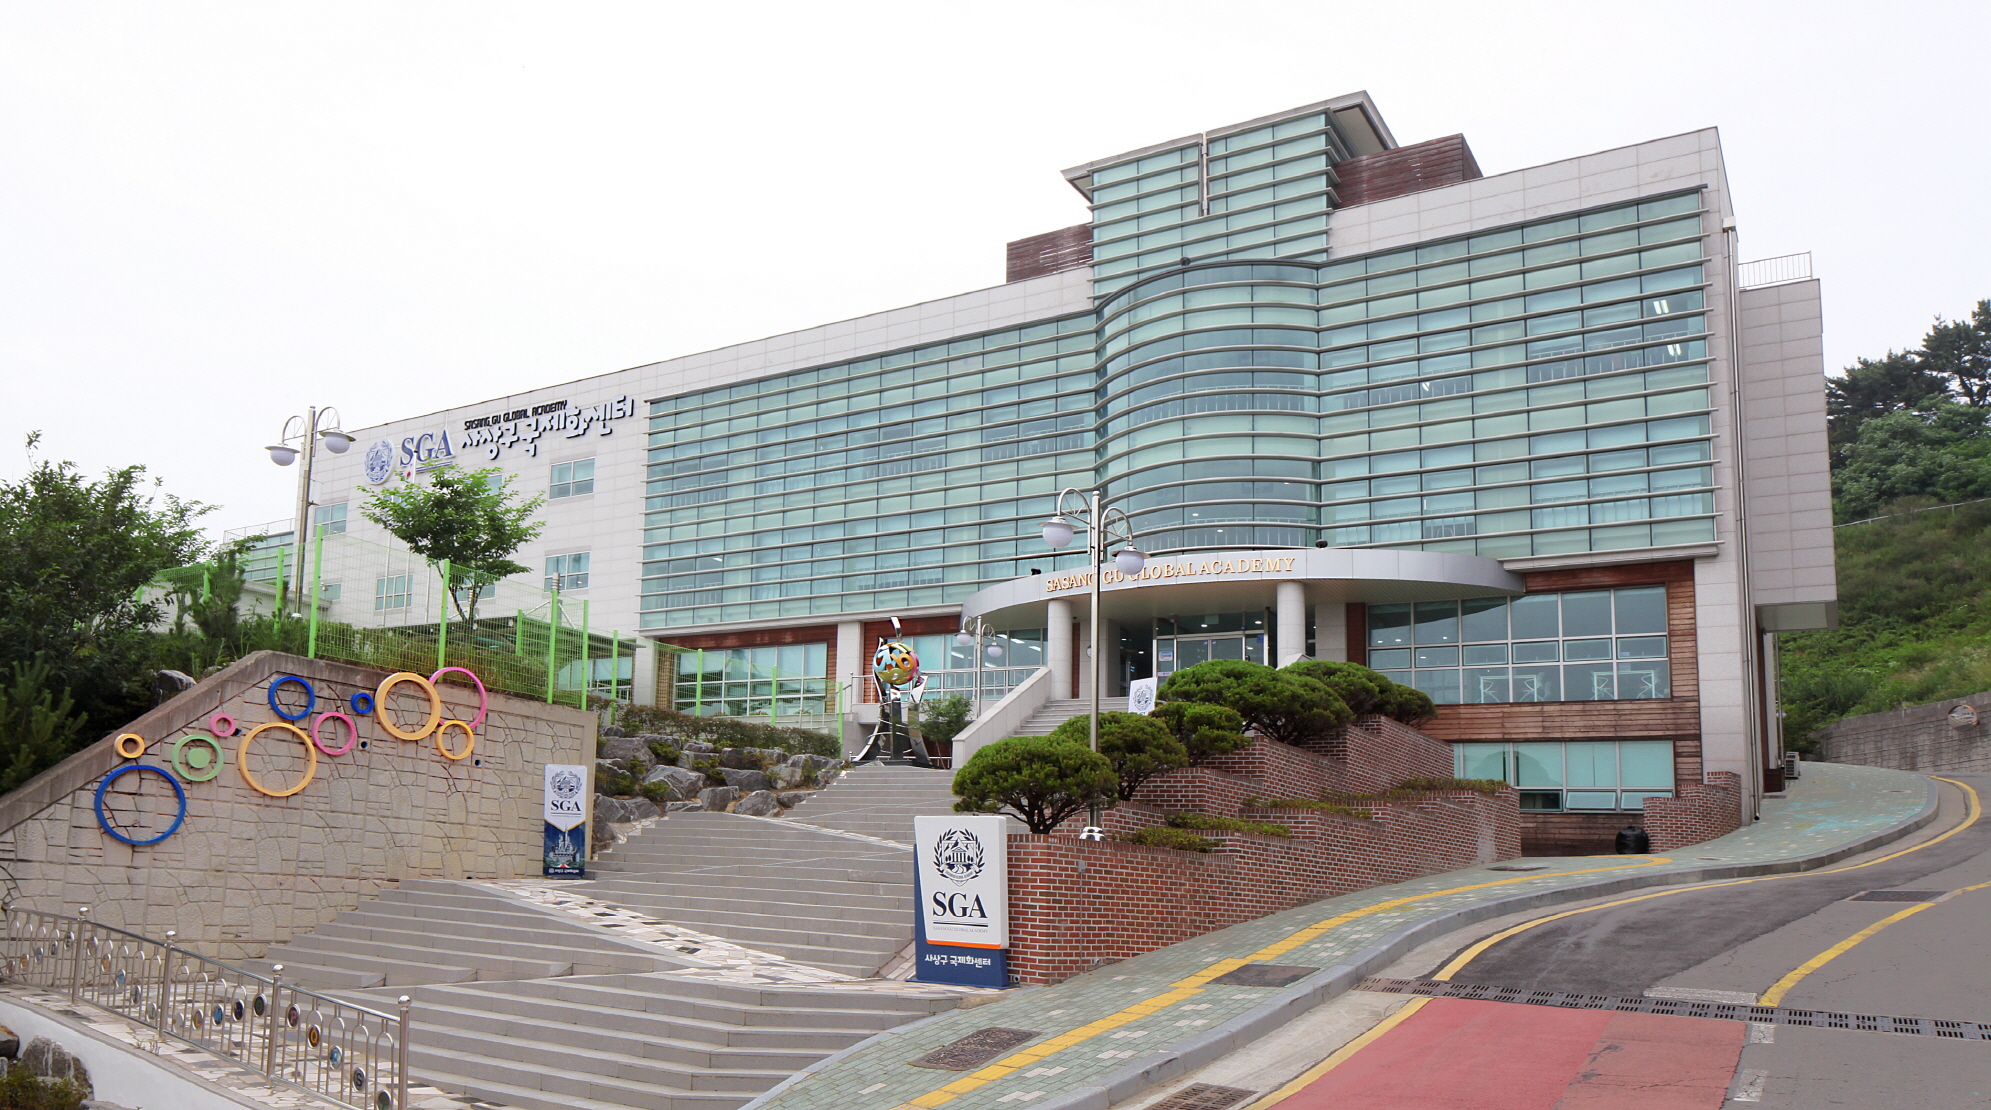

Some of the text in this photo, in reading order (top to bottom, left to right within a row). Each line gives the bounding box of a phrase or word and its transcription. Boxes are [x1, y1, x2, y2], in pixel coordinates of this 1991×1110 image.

[464, 400, 568, 431] SASANG GU GLOBAL ACADEMY
[400, 429, 454, 467] SGA
[461, 421, 519, 460] 사상구
[1102, 569, 1125, 585] GU
[1199, 557, 1295, 576] ACADEMY
[550, 799, 582, 812] SGA
[932, 891, 988, 919] SGA
[925, 954, 991, 969] 사상구 국제화센터
